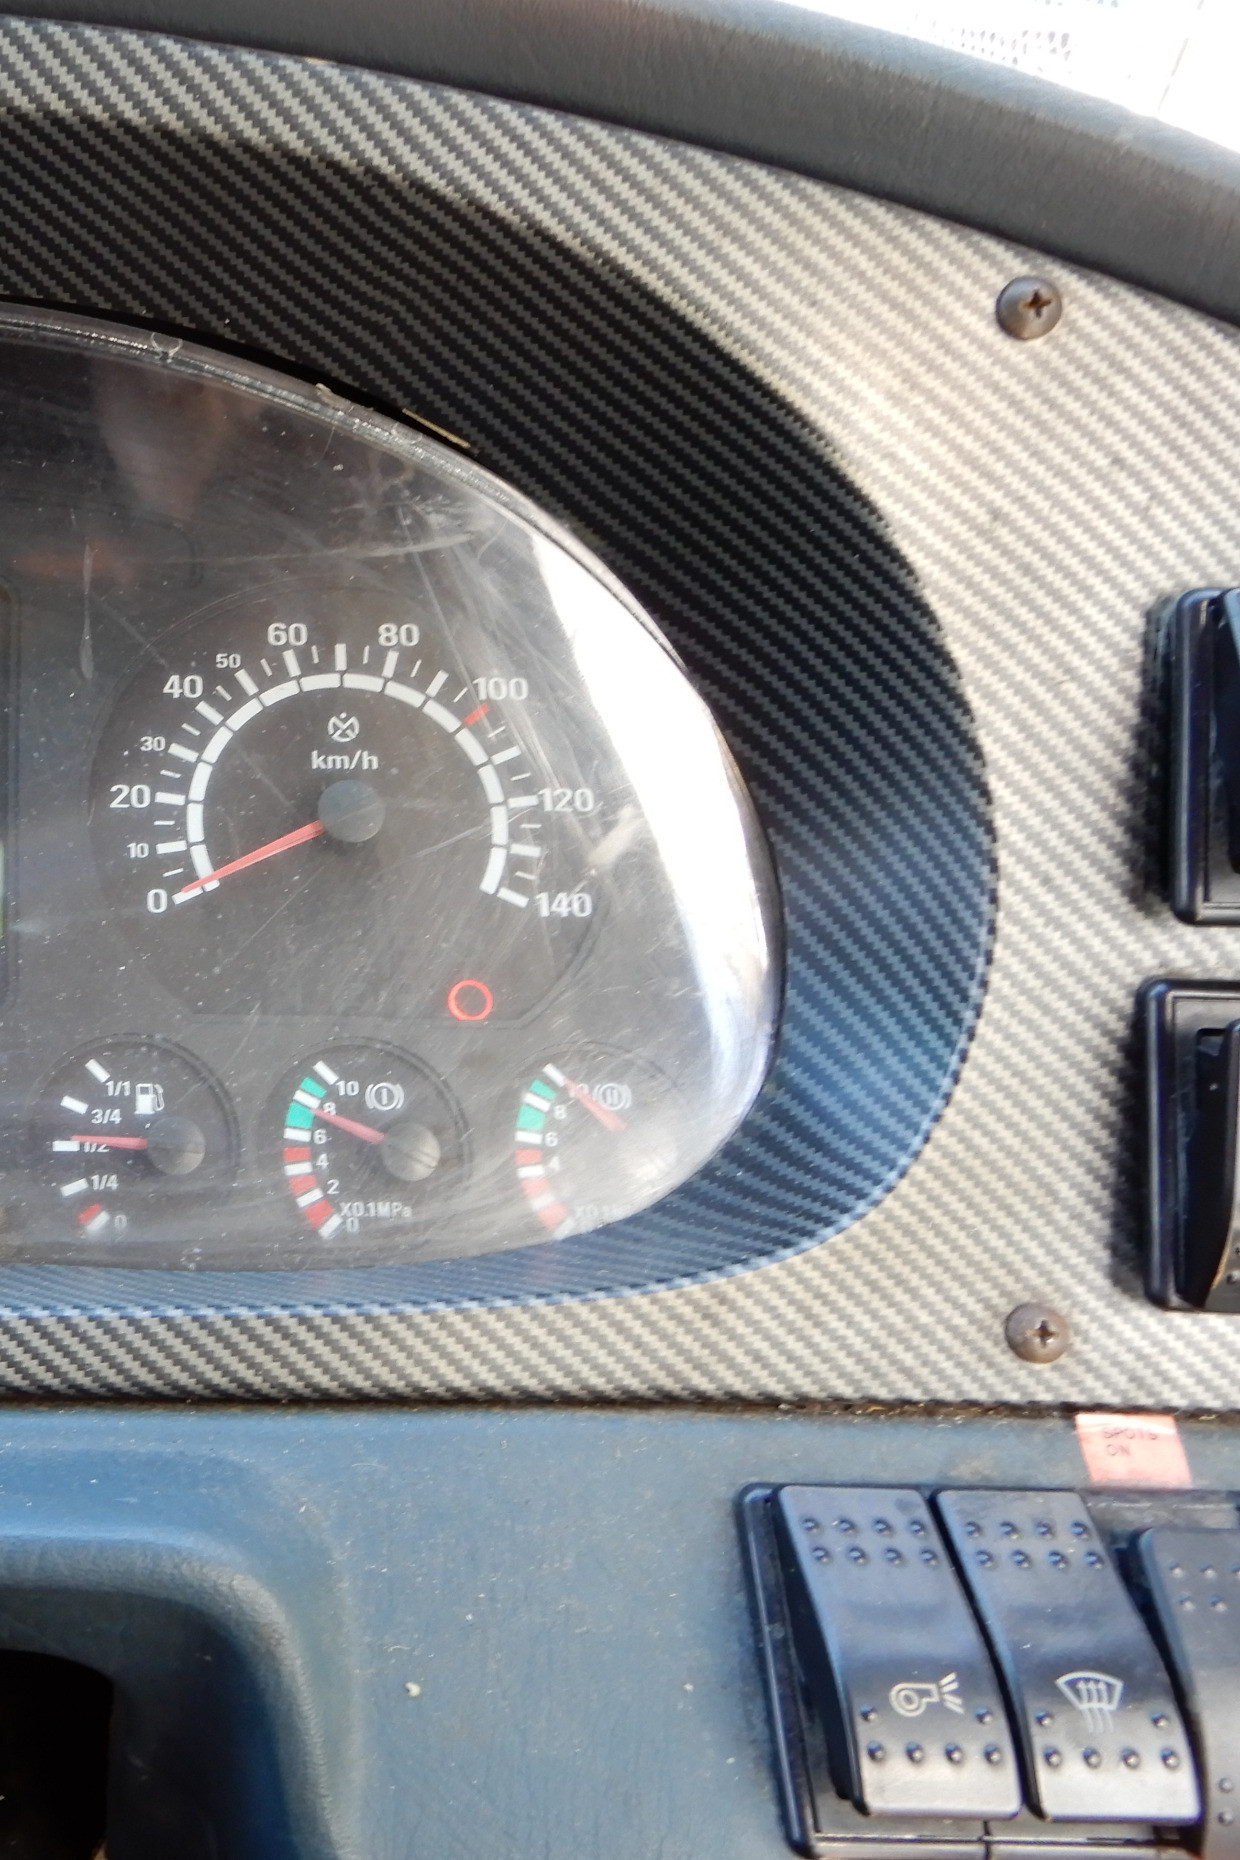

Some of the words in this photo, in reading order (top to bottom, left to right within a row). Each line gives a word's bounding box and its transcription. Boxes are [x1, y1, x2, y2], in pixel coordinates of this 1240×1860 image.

[267, 623, 308, 646] 60
[378, 623, 420, 646] 80
[215, 653, 241, 668] 50
[162, 675, 203, 699] 40
[473, 676, 529, 702] 100
[140, 736, 166, 752] 30
[311, 750, 379, 770] km/h
[109, 785, 151, 809] 20
[537, 788, 595, 813] 120
[127, 842, 149, 859] 10
[146, 889, 168, 914] 0
[537, 893, 592, 918] 140
[105, 1080, 131, 1096] 1/1
[335, 1080, 359, 1096] 10
[91, 1108, 122, 1124] 3/4
[553, 1104, 567, 1120] 8
[313, 1128, 327, 1144] 6
[544, 1131, 559, 1147] 6
[316, 1153, 329, 1170] 4
[90, 1174, 119, 1190] 1/4
[326, 1178, 340, 1194] 2
[345, 1217, 360, 1232] 0
